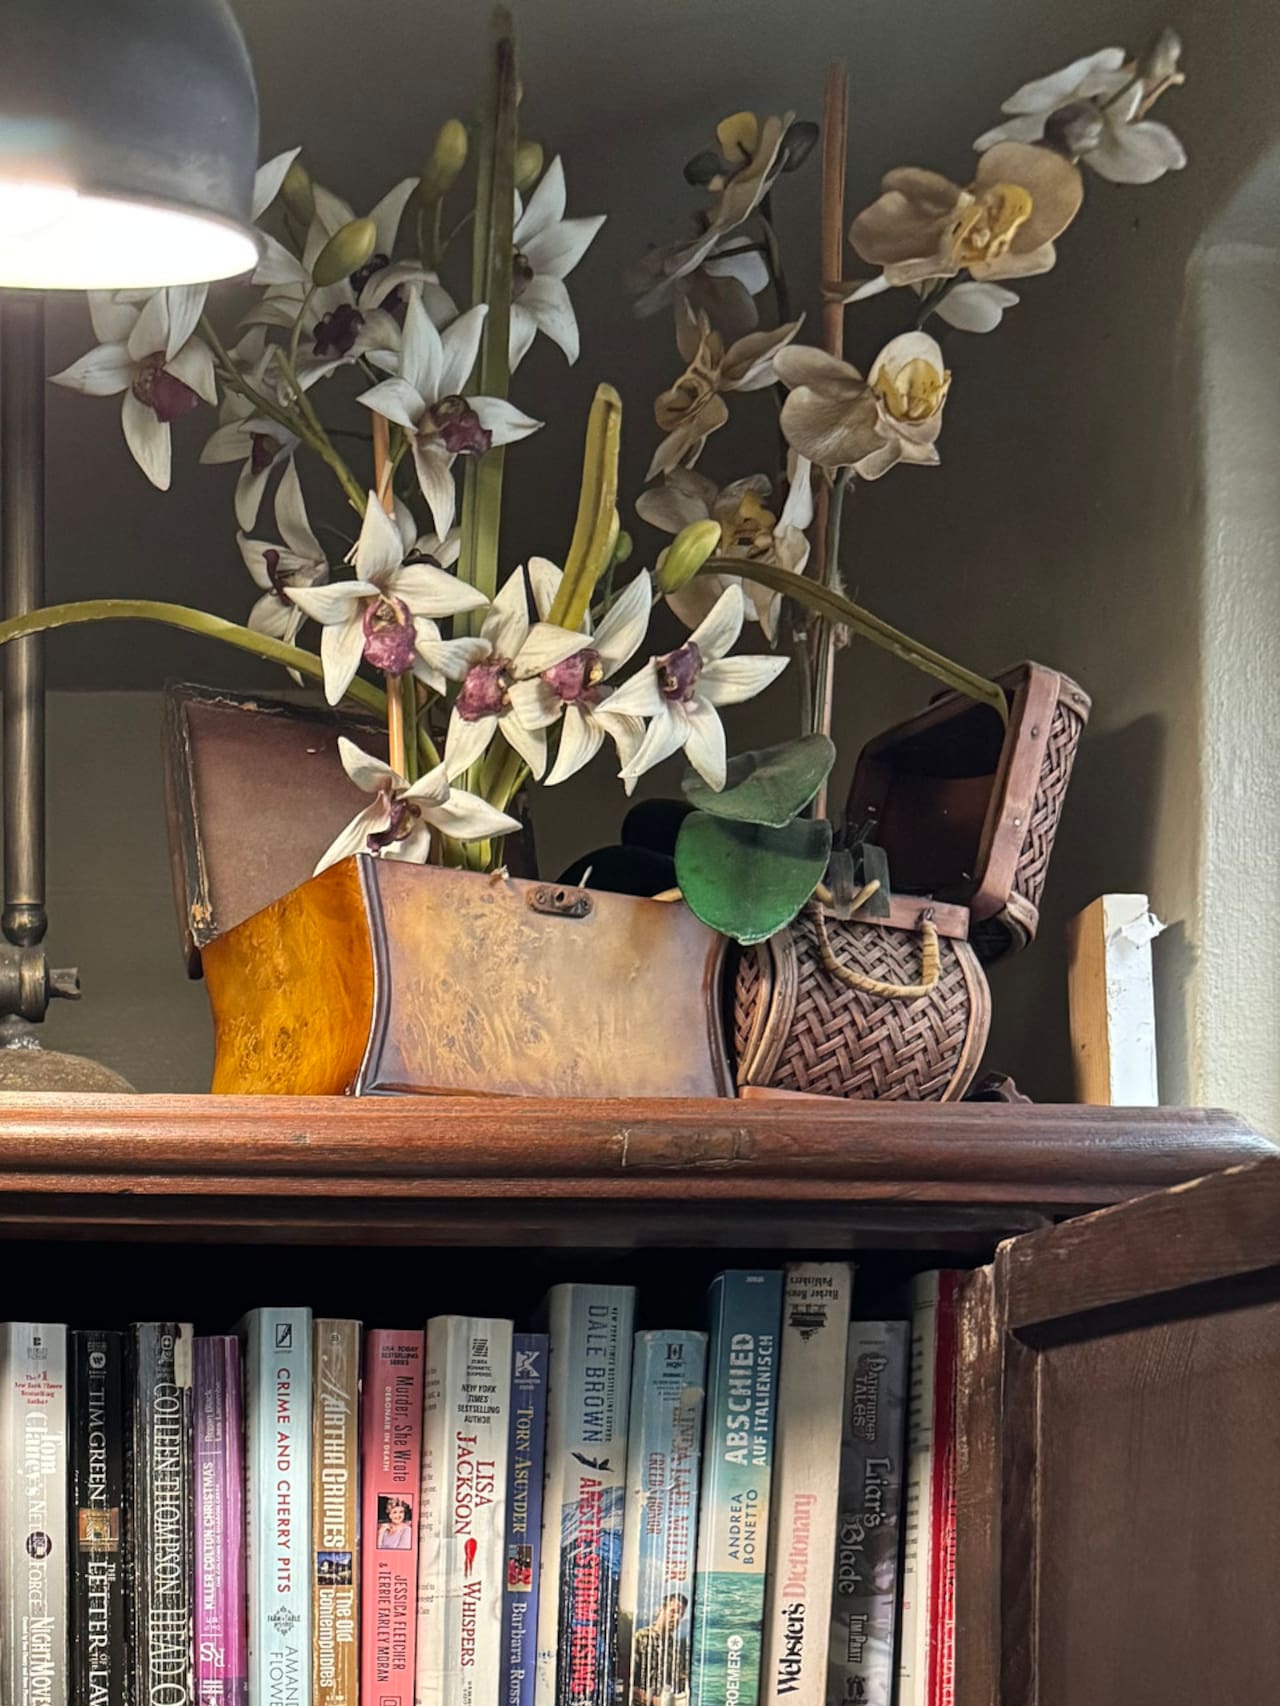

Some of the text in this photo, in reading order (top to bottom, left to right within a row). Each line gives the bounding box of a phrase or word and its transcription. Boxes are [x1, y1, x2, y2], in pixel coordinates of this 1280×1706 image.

[582, 1305, 609, 1442] DALE BROWN
[723, 1332, 755, 1466] ABSCHIED
[752, 1334, 773, 1466] AUF ITALIENISCH
[276, 1367, 291, 1594] CRIME AND CHERRY PITS
[456, 1431, 477, 1536] JACKSON
[474, 1459, 495, 1509] LISA
[728, 1492, 743, 1561] ANDREA
[743, 1489, 758, 1566] BONETTO
[459, 1581, 481, 1667] WHISPERS
[511, 1603, 528, 1703] Barbara Ross
